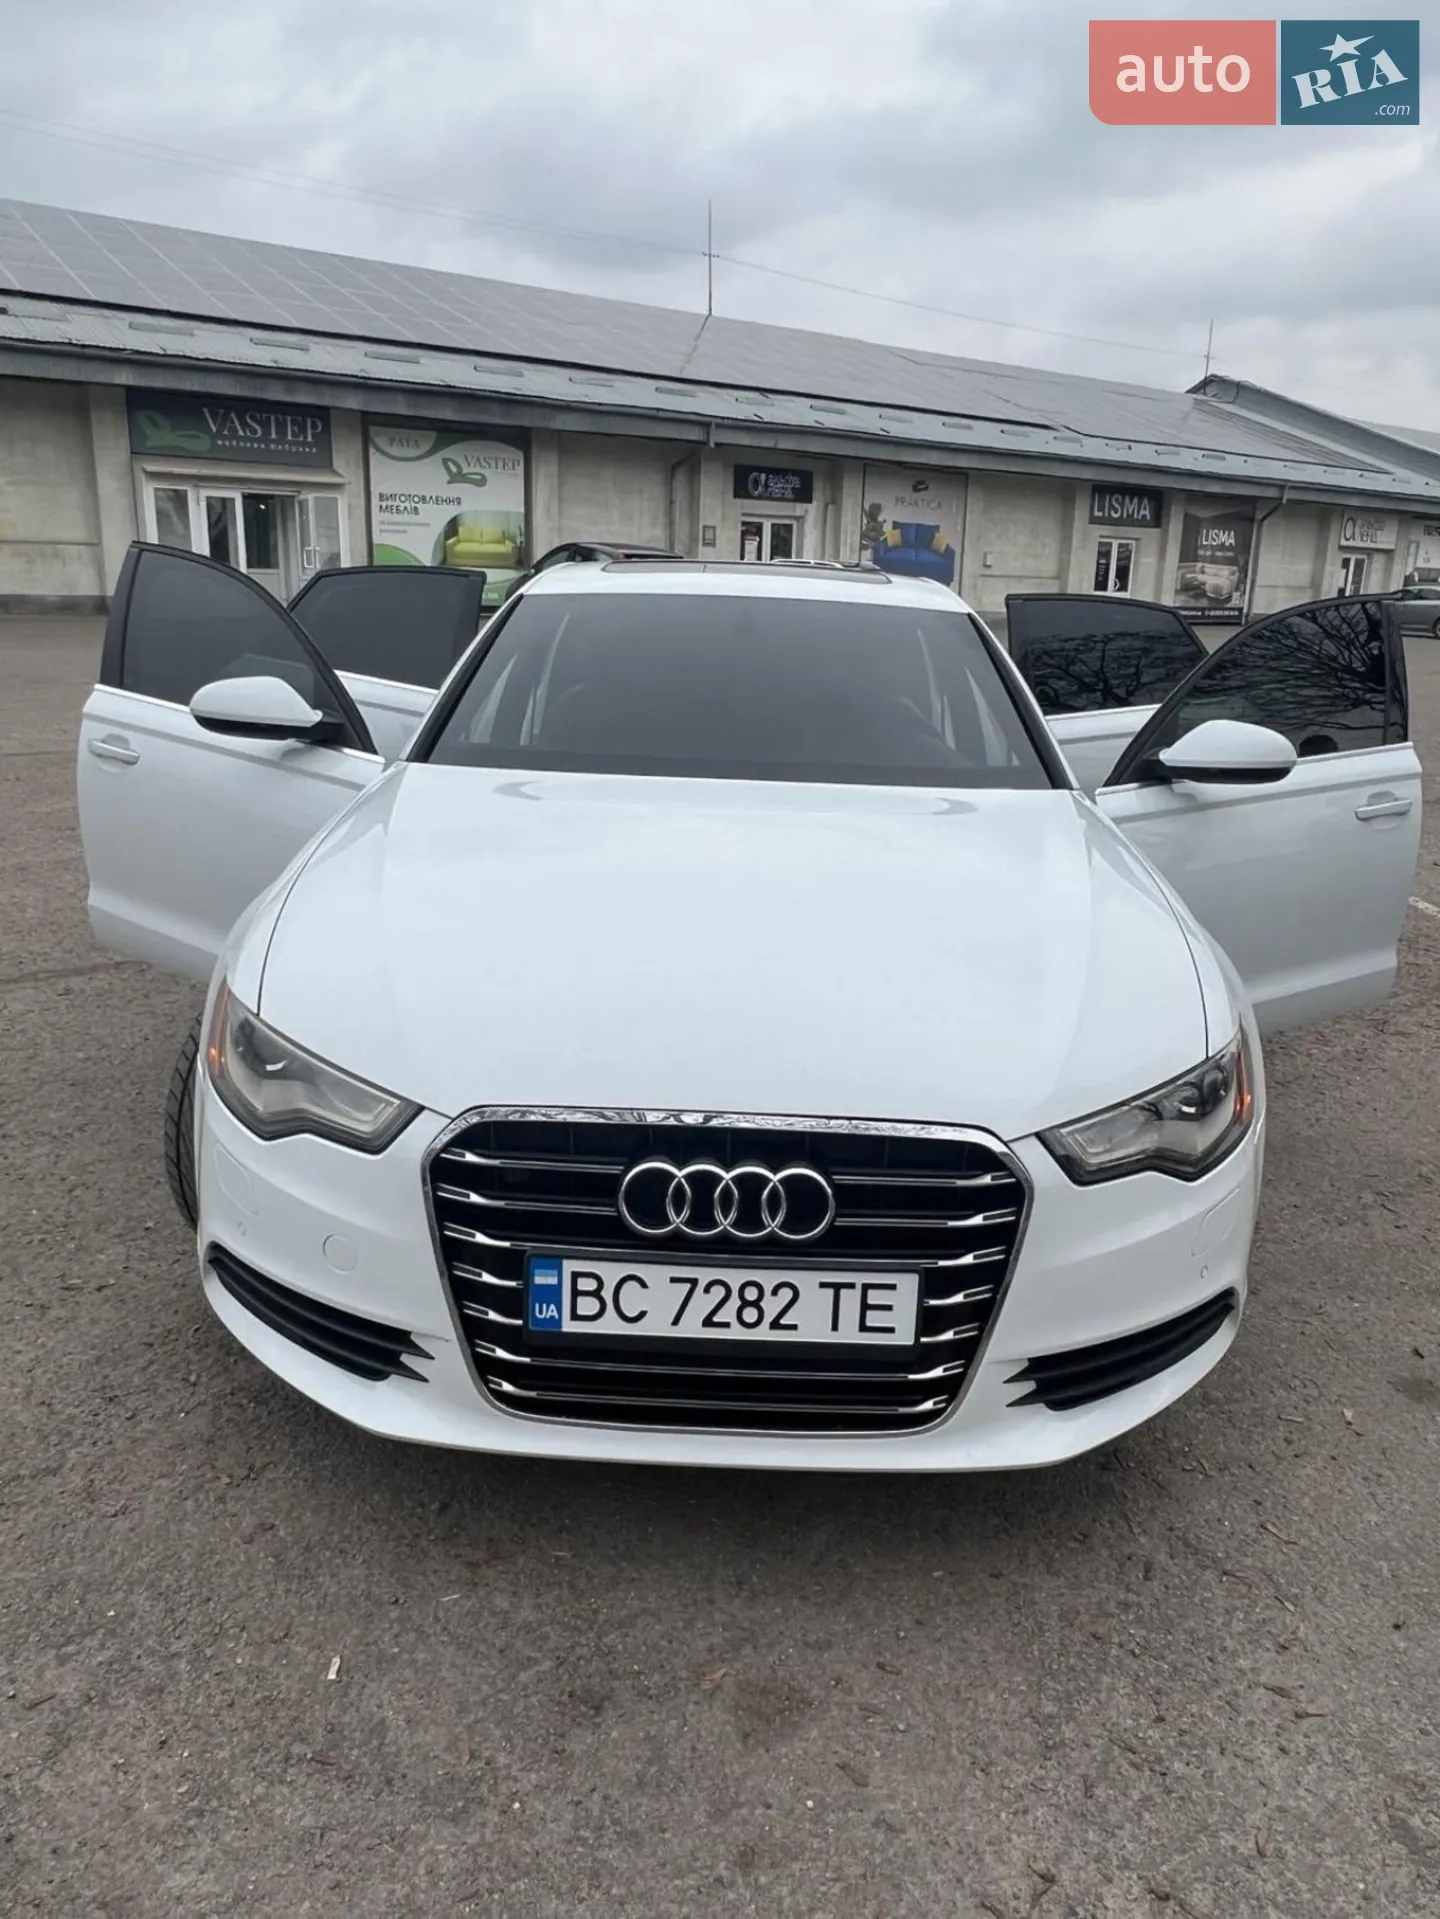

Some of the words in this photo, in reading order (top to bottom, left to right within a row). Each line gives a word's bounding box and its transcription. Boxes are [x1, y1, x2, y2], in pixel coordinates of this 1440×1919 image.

[202, 407, 322, 442] VASTEP
[464, 453, 521, 471] VASTEP
[378, 492, 462, 507] ВИГОТОВЛЕННЯ
[1094, 492, 1151, 520] LISMA
[378, 504, 421, 516] МЕБЛІВ
[1202, 528, 1236, 546] LISMA
[535, 1302, 559, 1319] UA
[570, 1270, 650, 1324] BC
[669, 1276, 801, 1331] 7282
[819, 1281, 898, 1334] TE
